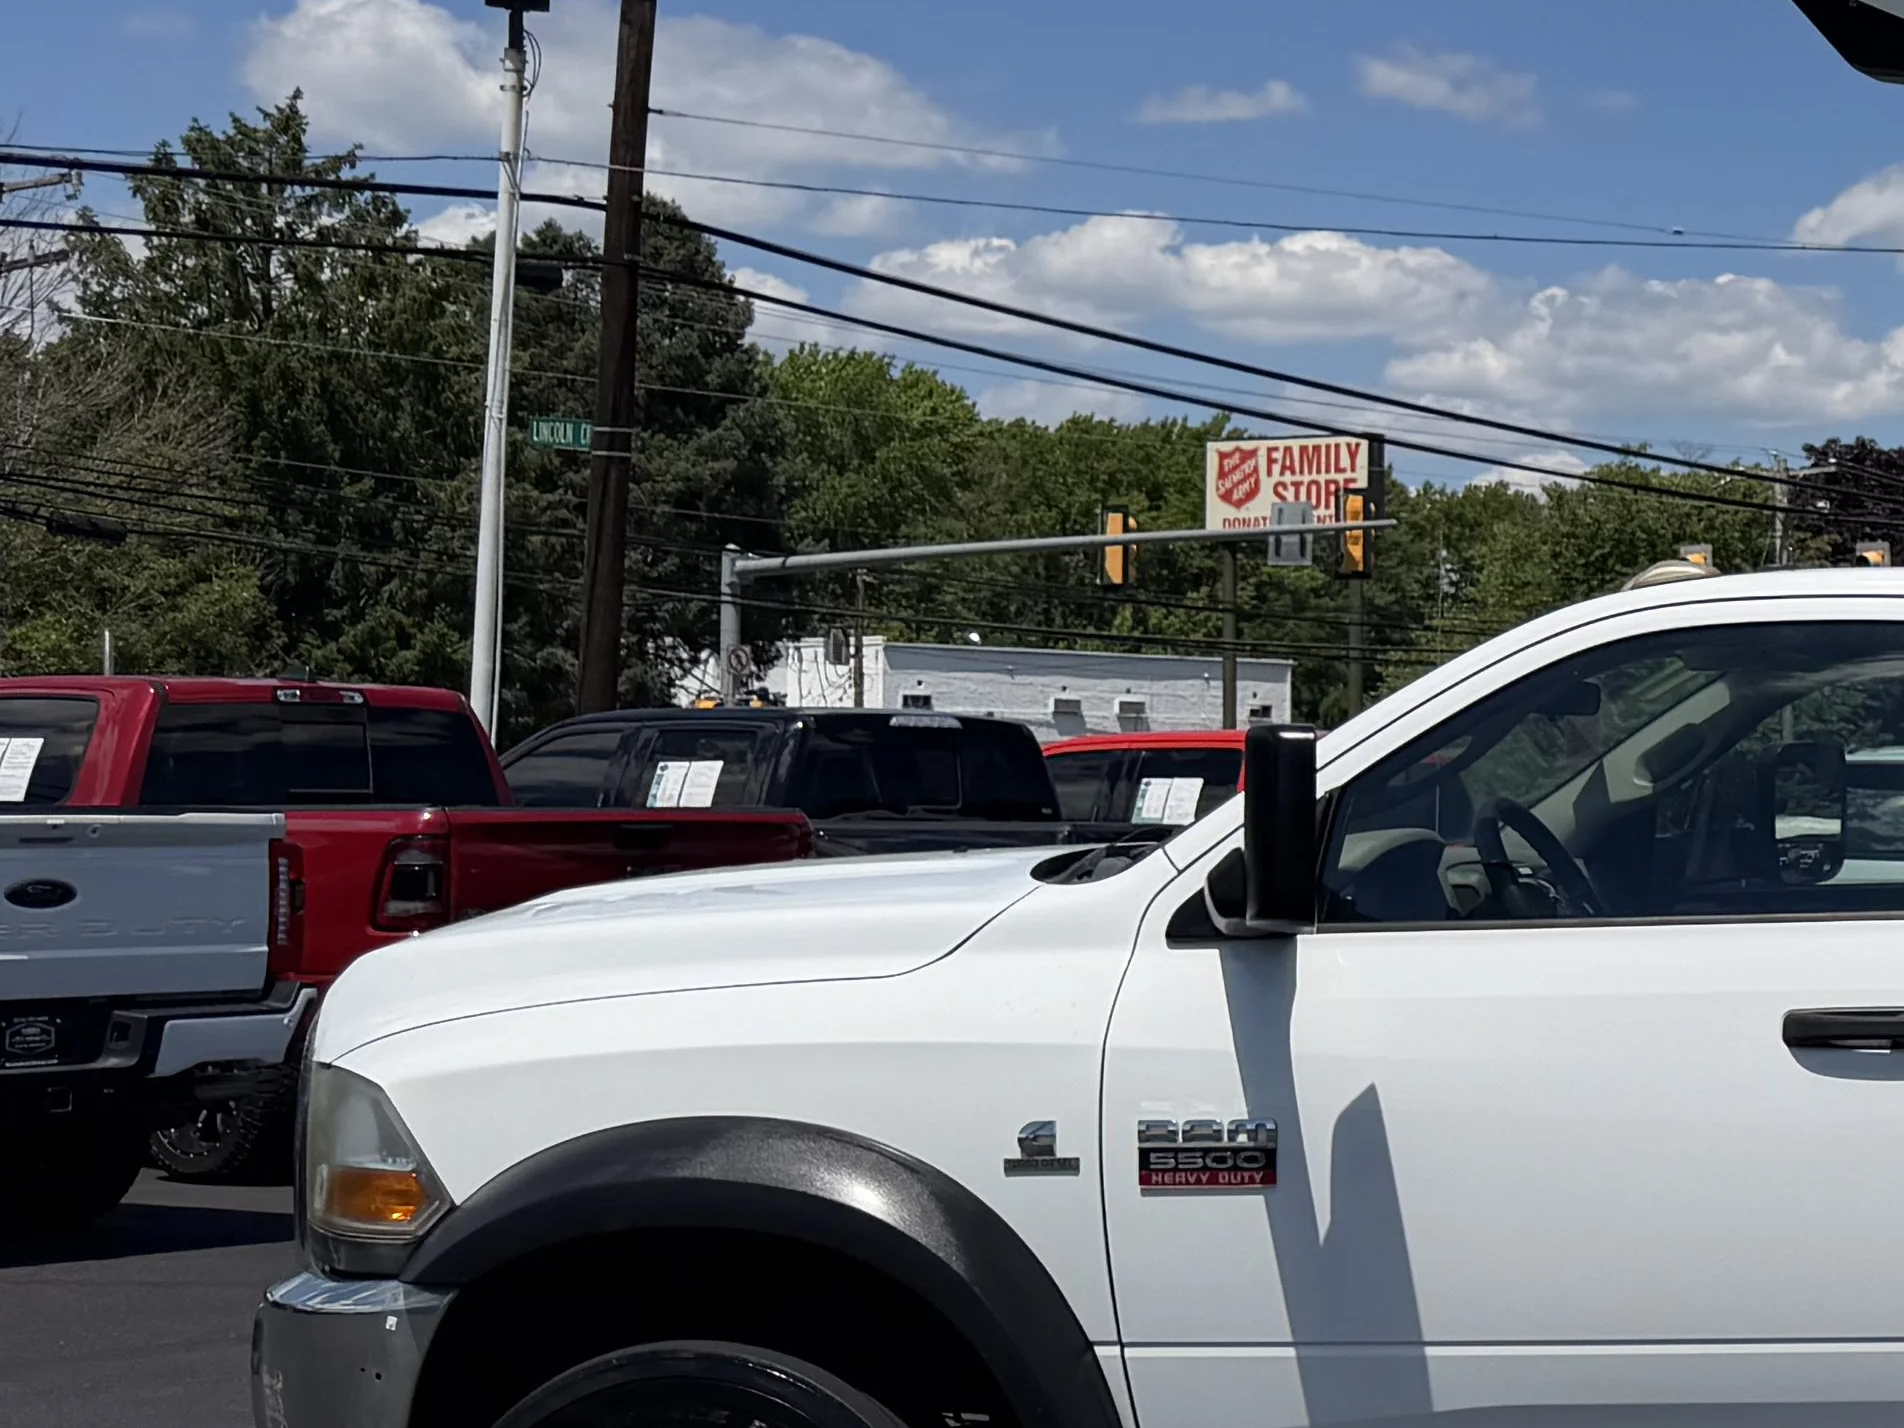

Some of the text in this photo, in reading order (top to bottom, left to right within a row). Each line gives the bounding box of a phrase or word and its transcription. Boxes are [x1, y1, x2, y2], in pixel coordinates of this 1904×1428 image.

[532, 420, 574, 444] LINCOLN
[1266, 442, 1361, 477] FAMILY
[1273, 478, 1358, 510] STOR
[1149, 1150, 1266, 1170] 5500
[1151, 1171, 1265, 1185] HEAVY DUTY
